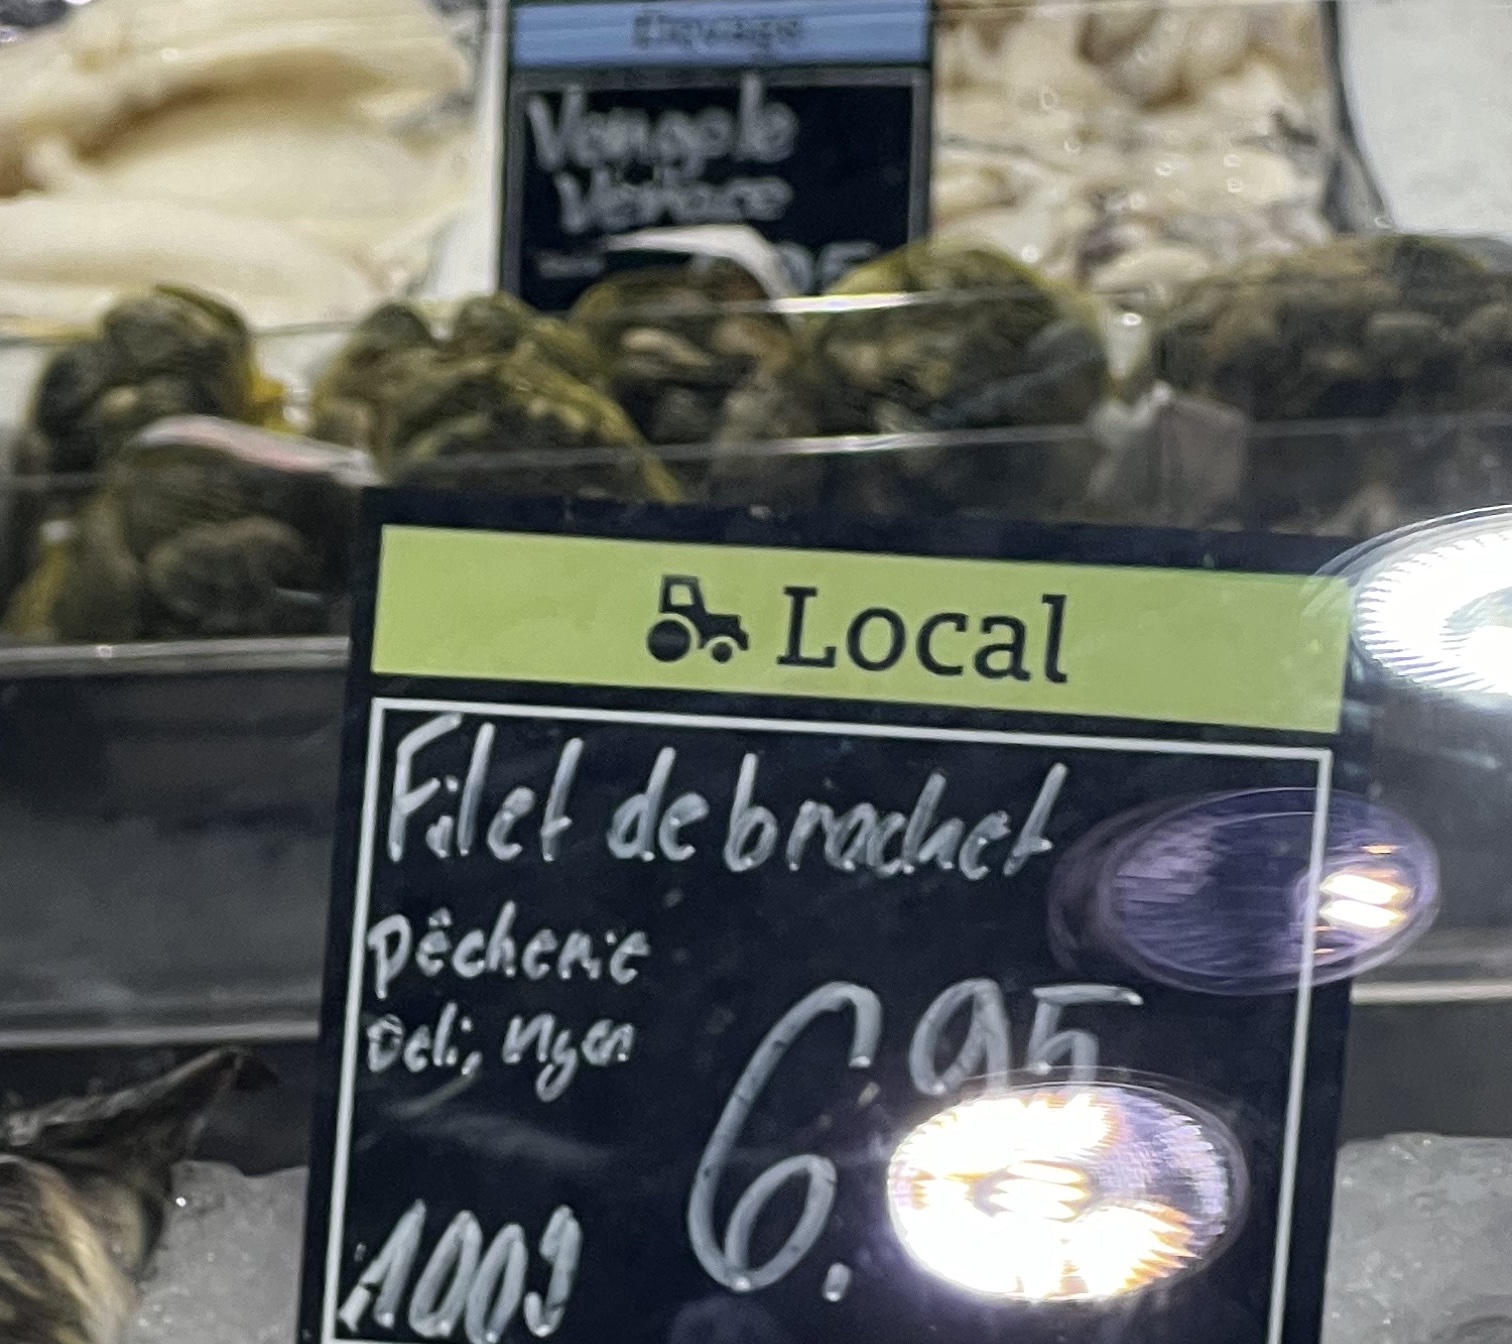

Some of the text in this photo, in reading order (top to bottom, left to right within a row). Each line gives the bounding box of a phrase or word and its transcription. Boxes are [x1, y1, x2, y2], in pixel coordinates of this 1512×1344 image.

[776, 585, 1068, 684] Local
[388, 711, 585, 863] Filet
[605, 745, 710, 862] de
